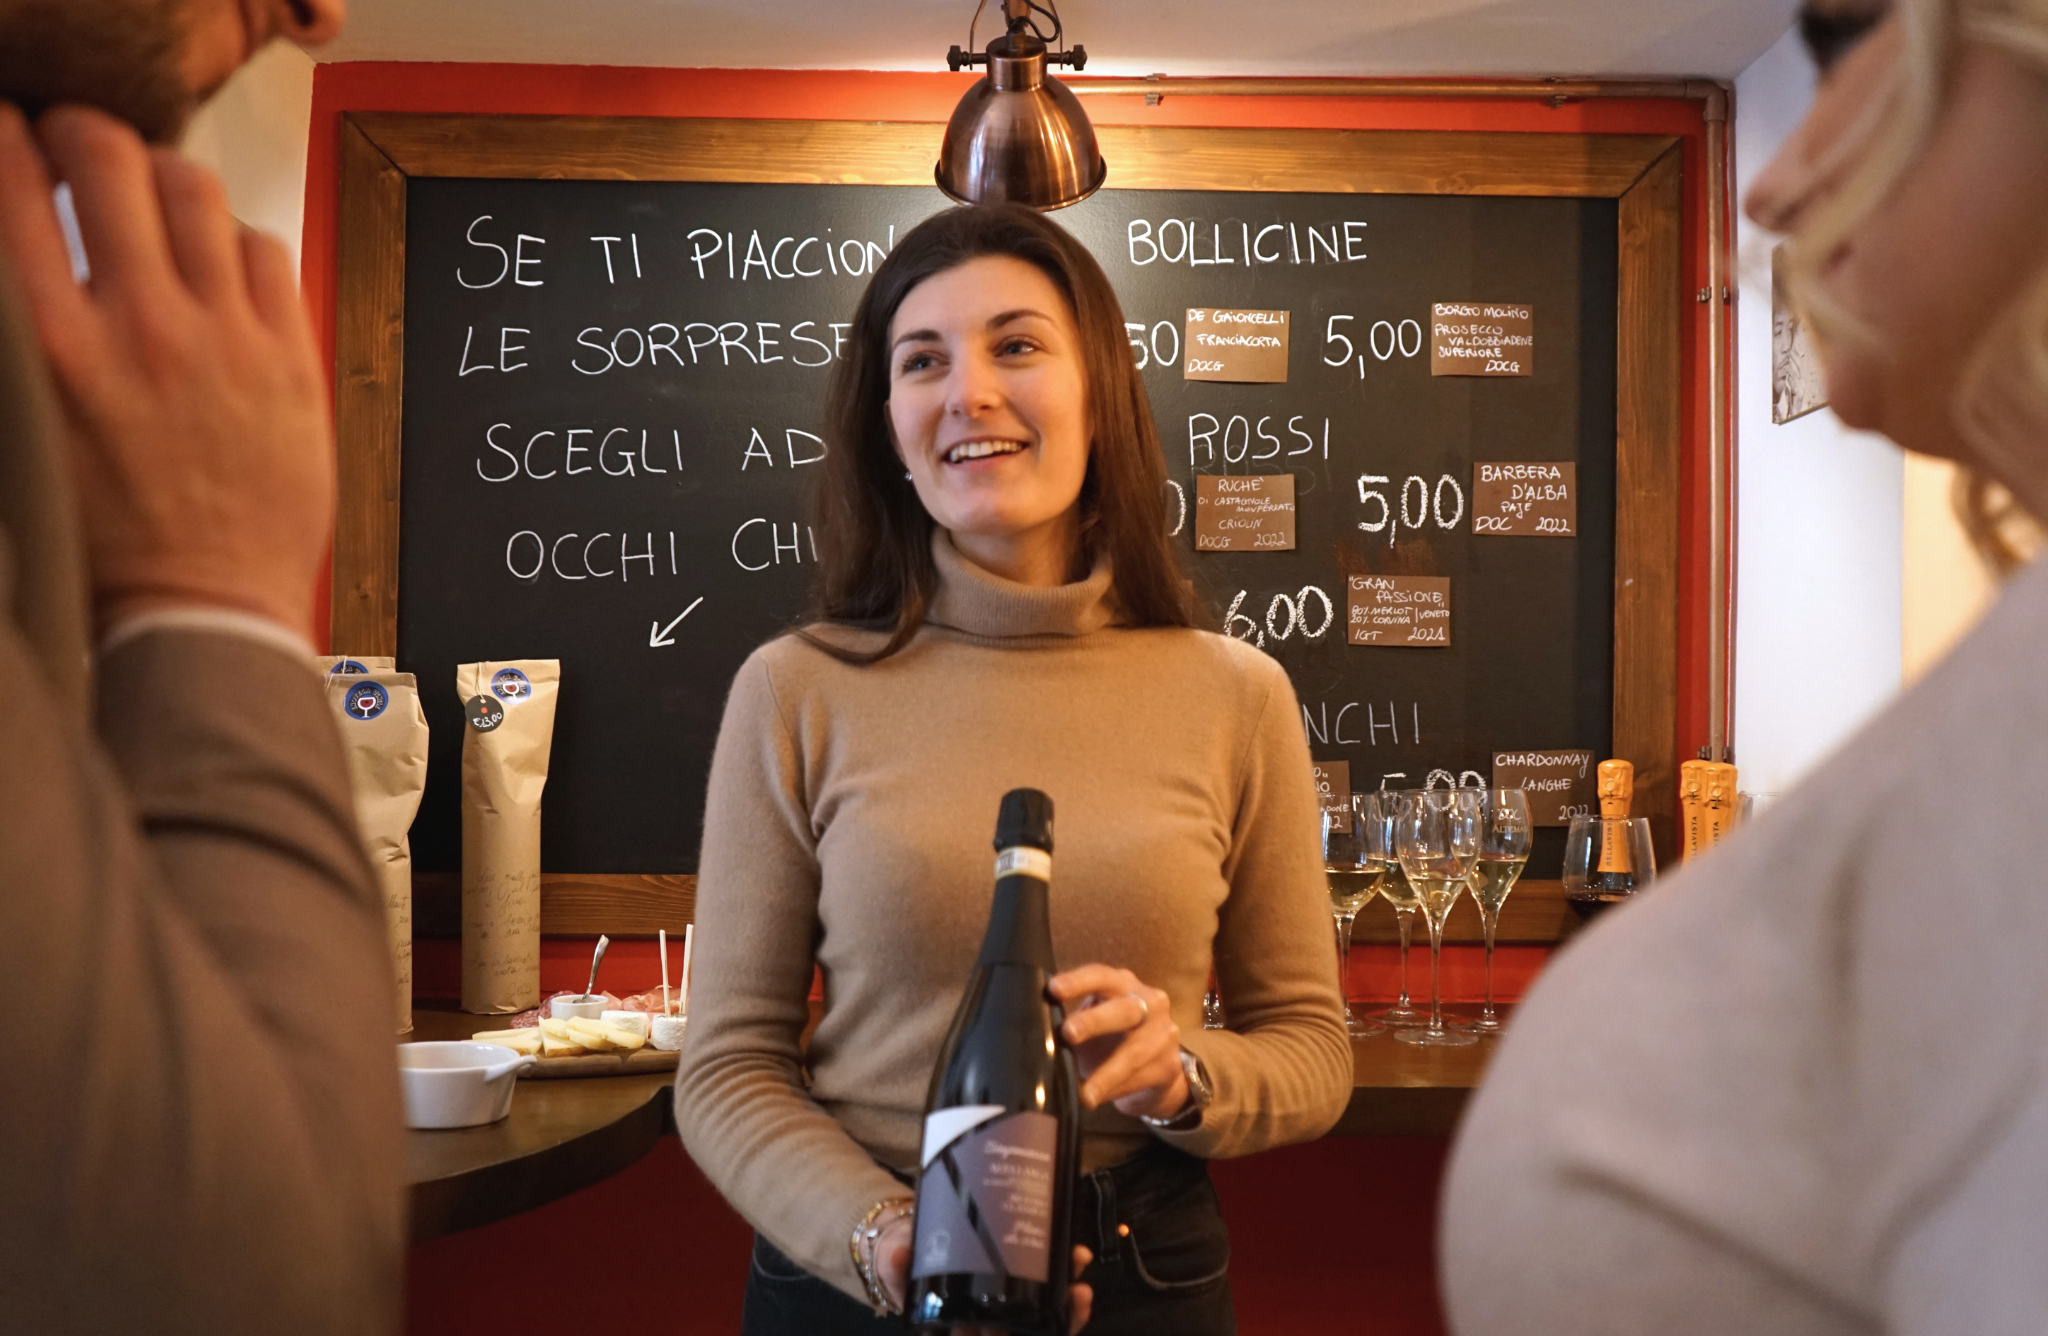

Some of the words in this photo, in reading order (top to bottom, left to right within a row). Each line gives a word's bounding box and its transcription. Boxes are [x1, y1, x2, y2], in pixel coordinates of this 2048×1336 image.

[456, 215, 546, 289] SE
[590, 232, 643, 285] TI
[1127, 218, 1368, 267] BOLLICINE
[1188, 308, 1206, 323] DE
[1434, 303, 1481, 317] BORGO
[1434, 323, 1504, 337] PROSECCO
[458, 325, 531, 377] LE
[1324, 314, 1423, 380] 5,00
[1187, 358, 1225, 373] DOCG
[1484, 359, 1521, 373] DOCG
[1188, 412, 1330, 467] ROSSI
[476, 422, 684, 482] SCEGLI
[741, 427, 829, 471] AD
[1481, 464, 1562, 483] BARBERA
[1510, 482, 1568, 501] D'ALBA
[1357, 472, 1465, 549] 5,00
[1475, 515, 1513, 532] DOC
[1535, 516, 1572, 533] 2022
[1199, 533, 1232, 549] DOCG
[1253, 531, 1288, 547] 2022
[506, 529, 678, 583] OCCHI
[731, 517, 819, 572] CHI
[1354, 628, 1383, 641] IGT
[1407, 626, 1446, 642] 2021
[1520, 776, 1572, 792] LANGHE
